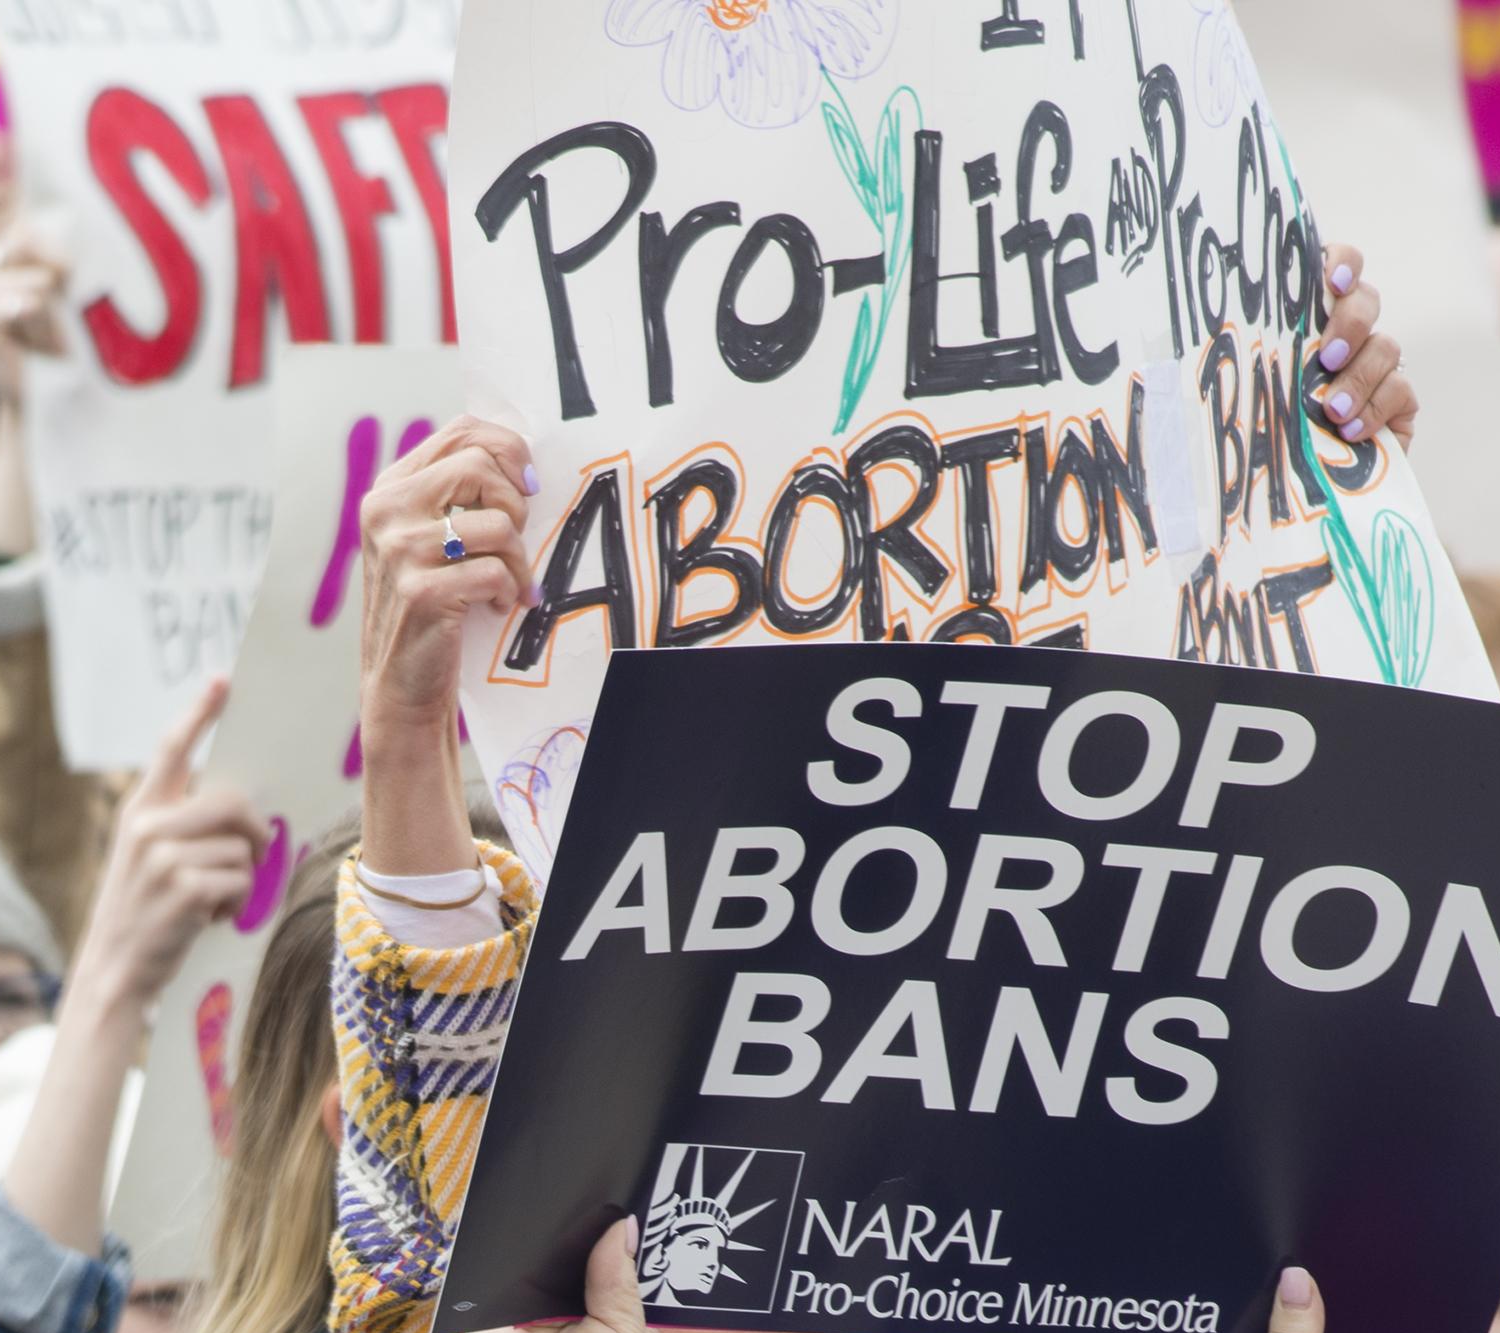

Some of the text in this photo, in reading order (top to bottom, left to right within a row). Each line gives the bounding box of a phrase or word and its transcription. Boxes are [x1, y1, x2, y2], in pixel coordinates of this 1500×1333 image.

[474, 100, 1120, 421] Pro-Life
[1105, 147, 1160, 258] AND
[490, 376, 1160, 684] ABORTION
[806, 676, 1317, 828] STOP
[699, 971, 1230, 1126] BANS
[783, 1269, 1002, 1326] Pro-Choice
[799, 1198, 1013, 1267] NARAL
